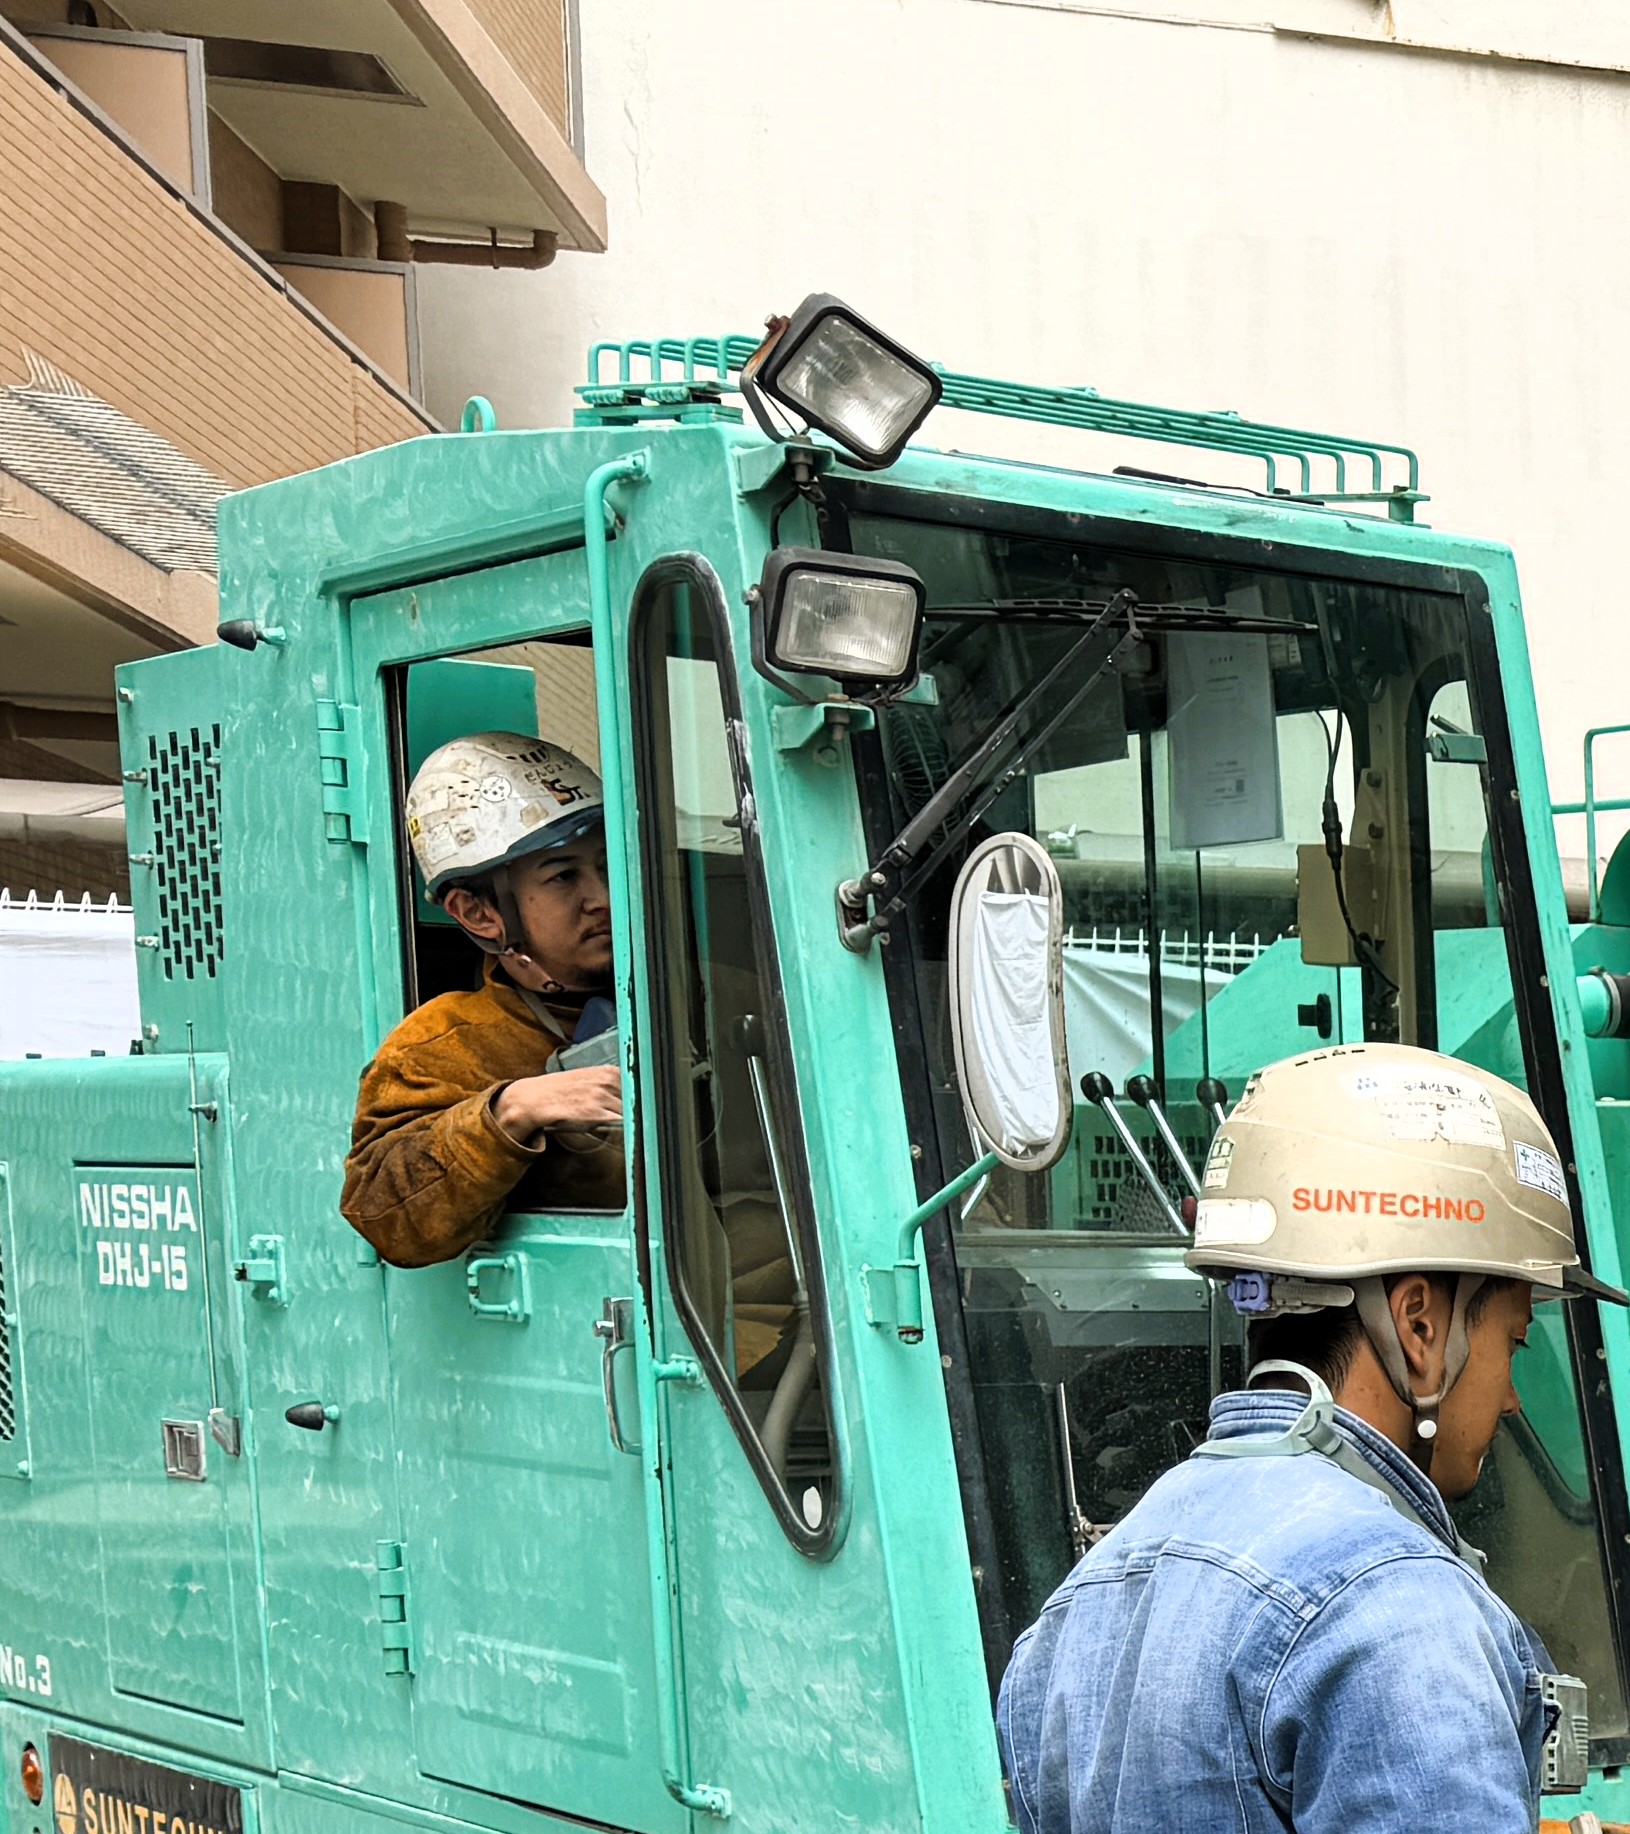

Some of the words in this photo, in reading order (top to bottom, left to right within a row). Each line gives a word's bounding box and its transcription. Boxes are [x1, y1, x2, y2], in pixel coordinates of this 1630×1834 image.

[79, 1182, 198, 1232] NISSHA
[1292, 1187, 1486, 1223] SUNTECHNO
[96, 1240, 188, 1291] DHJ-15
[0, 1645, 52, 1696] No.3
